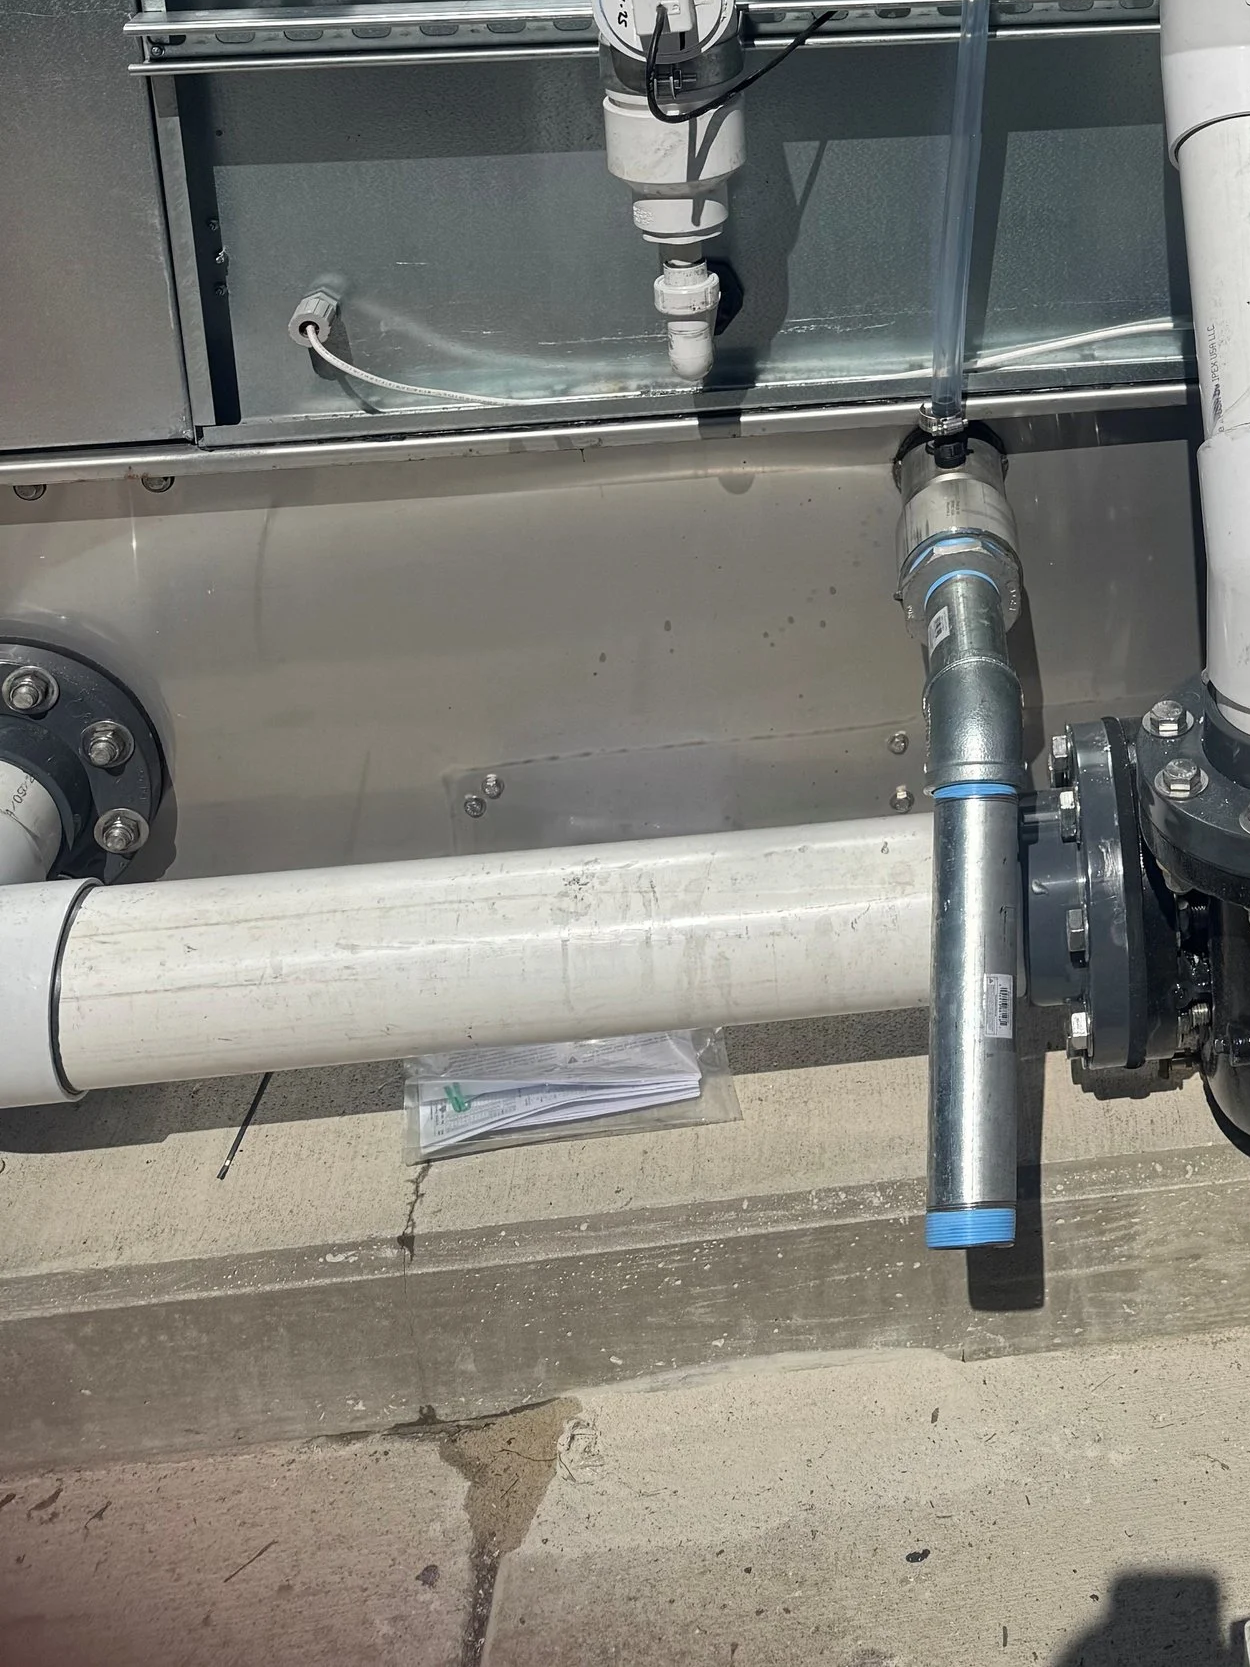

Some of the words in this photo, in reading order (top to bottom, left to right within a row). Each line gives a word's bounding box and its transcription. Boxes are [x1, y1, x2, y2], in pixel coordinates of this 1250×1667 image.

[1207, 324, 1215, 342] LLC
[1208, 343, 1217, 360] USA
[1211, 362, 1219, 382] IPEX
